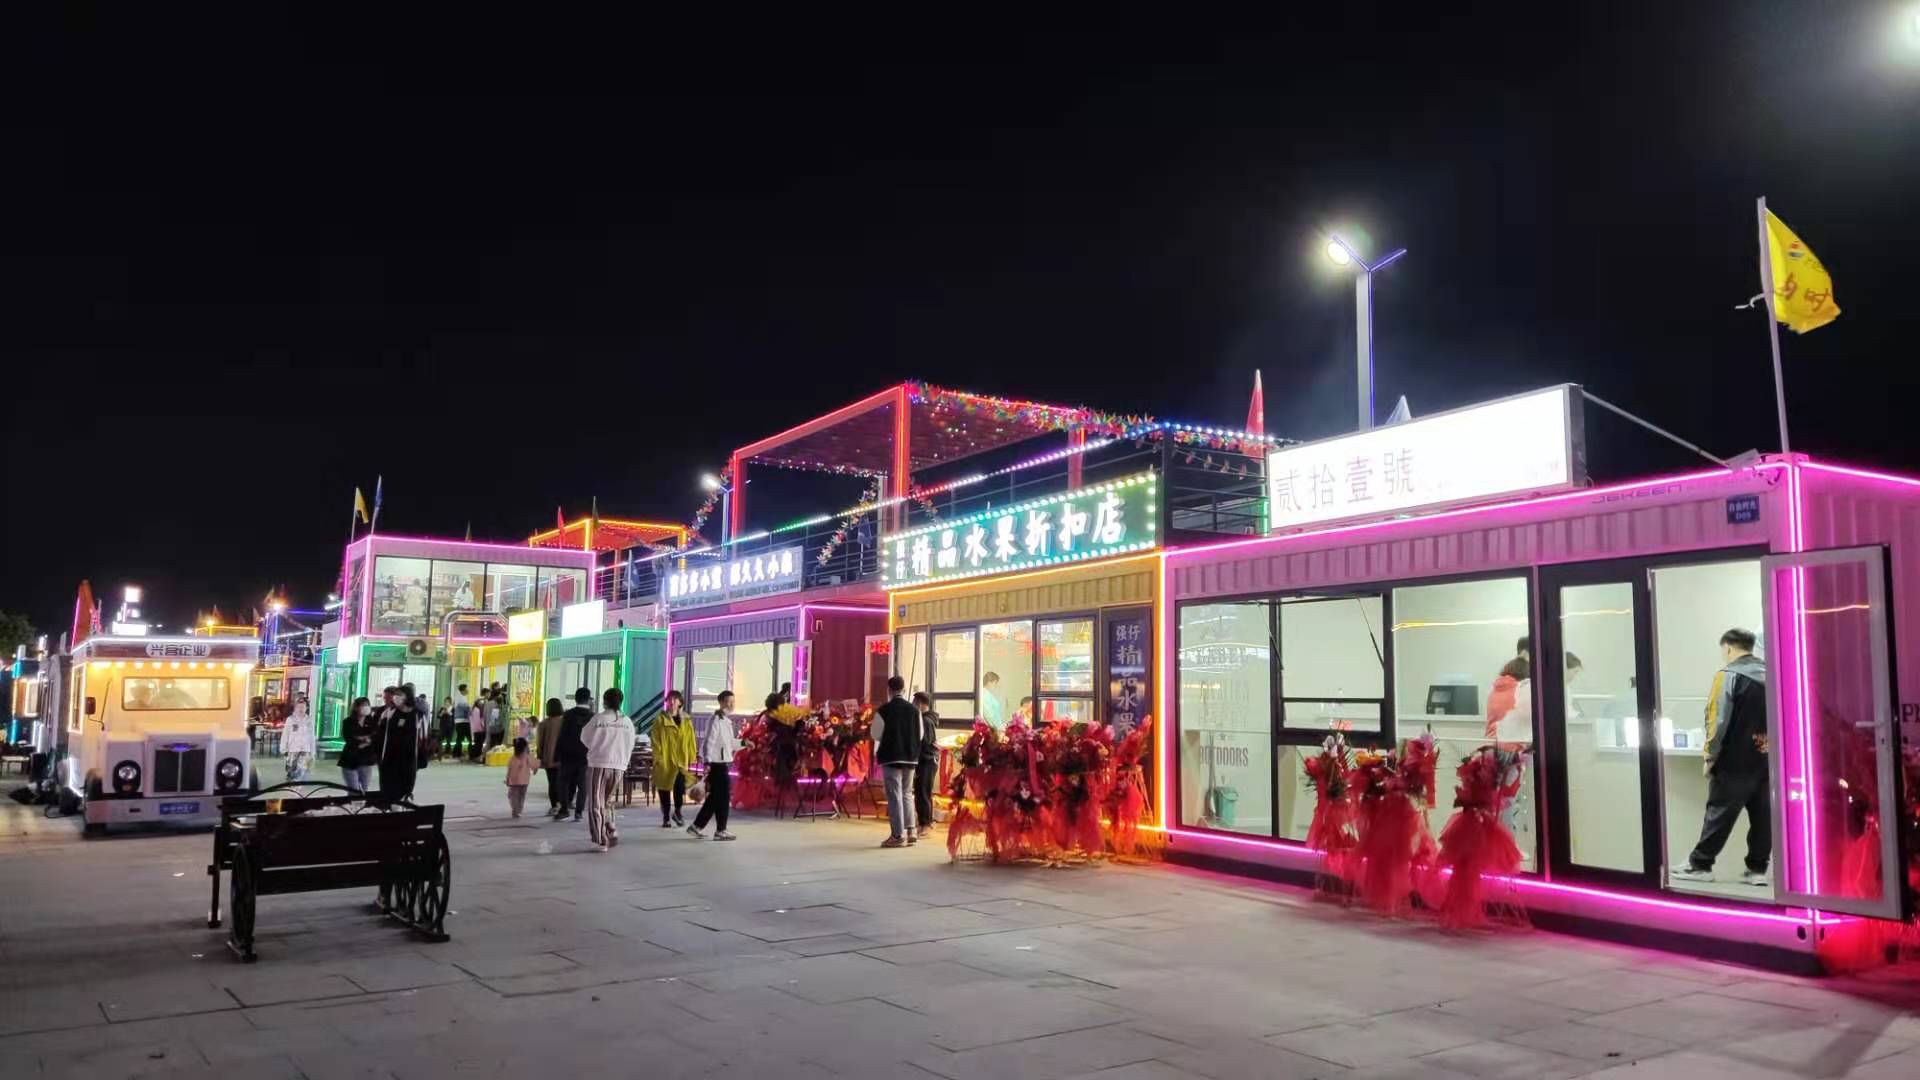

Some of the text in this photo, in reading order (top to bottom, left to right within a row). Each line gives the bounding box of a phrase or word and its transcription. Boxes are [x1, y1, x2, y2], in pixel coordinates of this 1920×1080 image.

[911, 492, 1124, 577] 精品水果折扣店
[1116, 625, 1140, 641] 强仔
